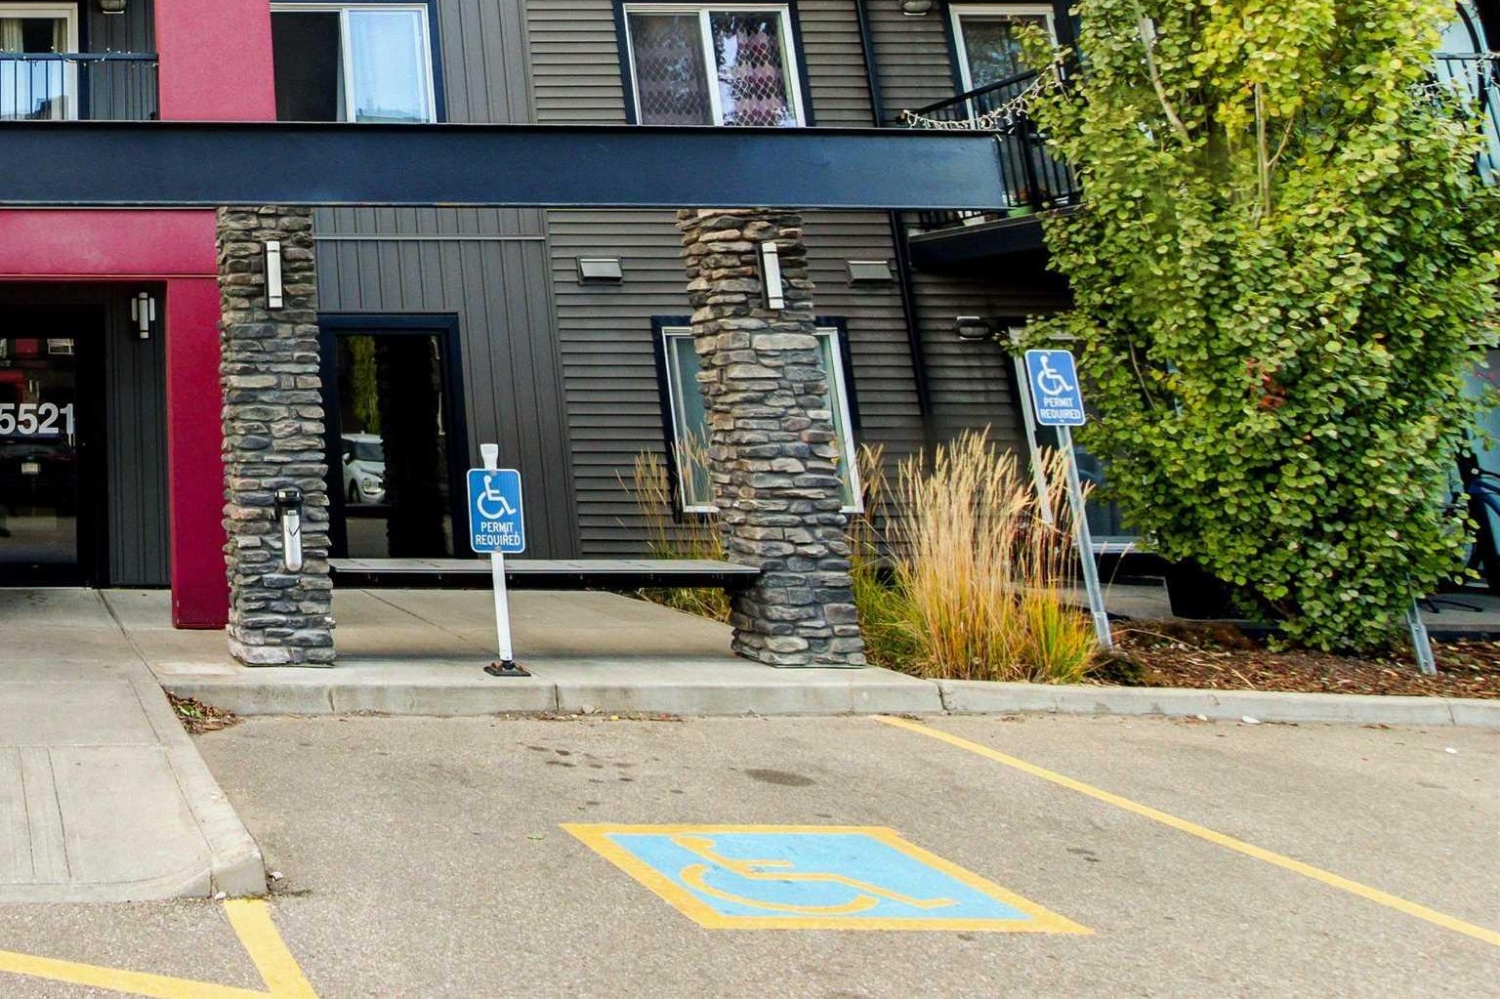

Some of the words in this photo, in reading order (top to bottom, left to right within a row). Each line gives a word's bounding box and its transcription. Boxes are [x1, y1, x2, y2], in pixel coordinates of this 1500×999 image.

[1043, 397, 1074, 408] PERMIT
[1039, 408, 1081, 419] REQUIRED
[480, 522, 514, 533] PERMIT
[475, 534, 521, 546] REQUIRED
